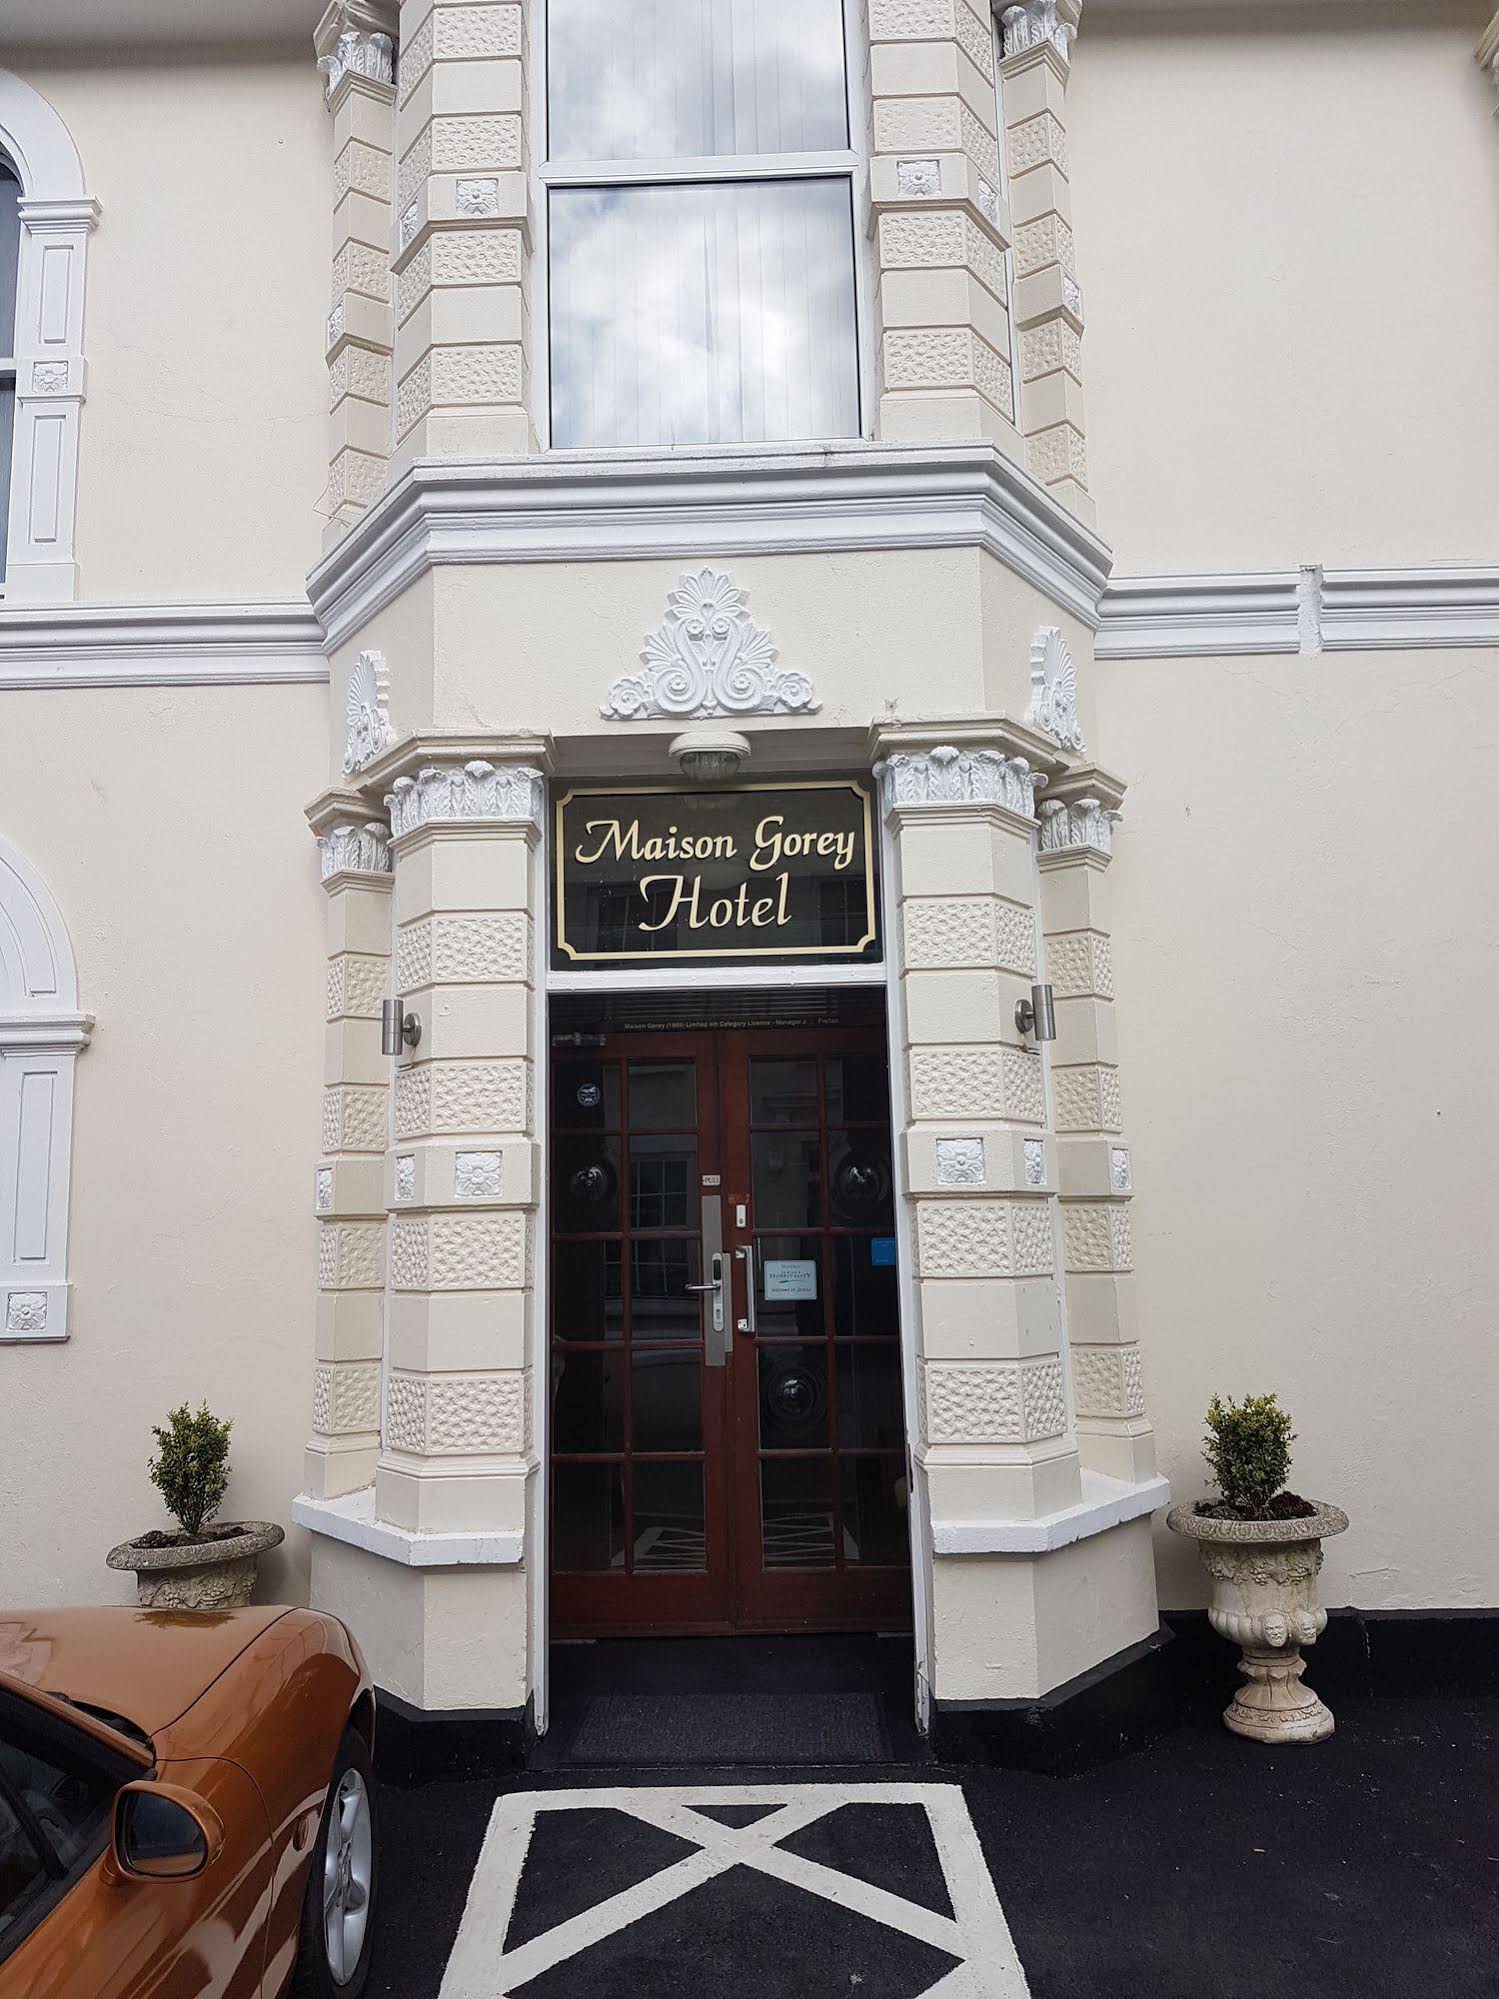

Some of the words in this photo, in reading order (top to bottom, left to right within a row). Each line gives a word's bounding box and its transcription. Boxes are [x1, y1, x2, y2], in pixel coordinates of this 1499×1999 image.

[575, 819, 737, 864] Maison
[749, 815, 855, 871] Gorey
[638, 872, 792, 931] Hotel
[647, 1022, 665, 1031] Gorey
[720, 1020, 746, 1028] Category
